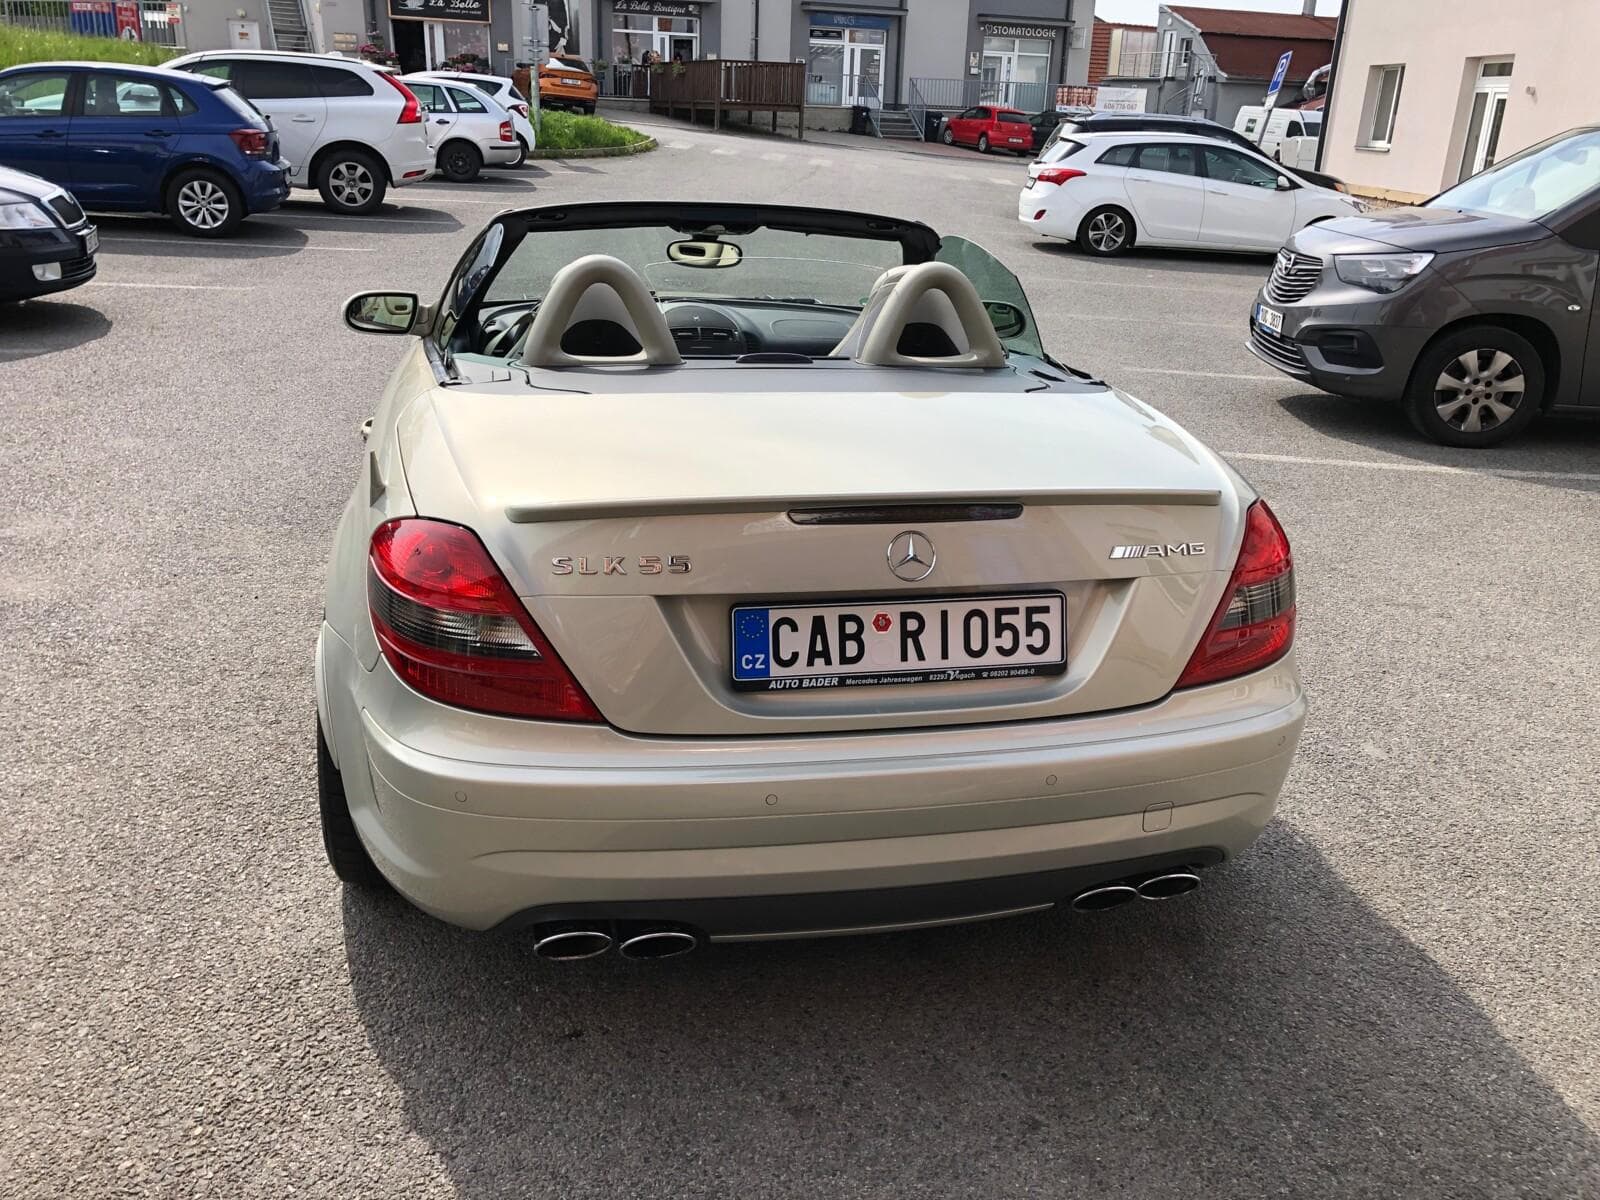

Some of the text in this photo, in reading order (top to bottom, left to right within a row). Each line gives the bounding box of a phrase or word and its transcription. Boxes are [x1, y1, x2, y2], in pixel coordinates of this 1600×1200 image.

[449, 0, 481, 9] Belle
[630, 0, 651, 11] Belle
[653, 1, 686, 16] Boutique
[993, 25, 1057, 38] STOMATOLOGIE
[1274, 58, 1287, 82] P
[1142, 542, 1206, 558] AMG
[552, 554, 692, 576] SLK 55
[771, 613, 866, 668] CAB
[741, 653, 766, 670] CZ
[768, 679, 799, 689] AUTO
[802, 677, 839, 688] BADER
[845, 677, 878, 685] Mercedes
[879, 674, 923, 684] Jahreswagen
